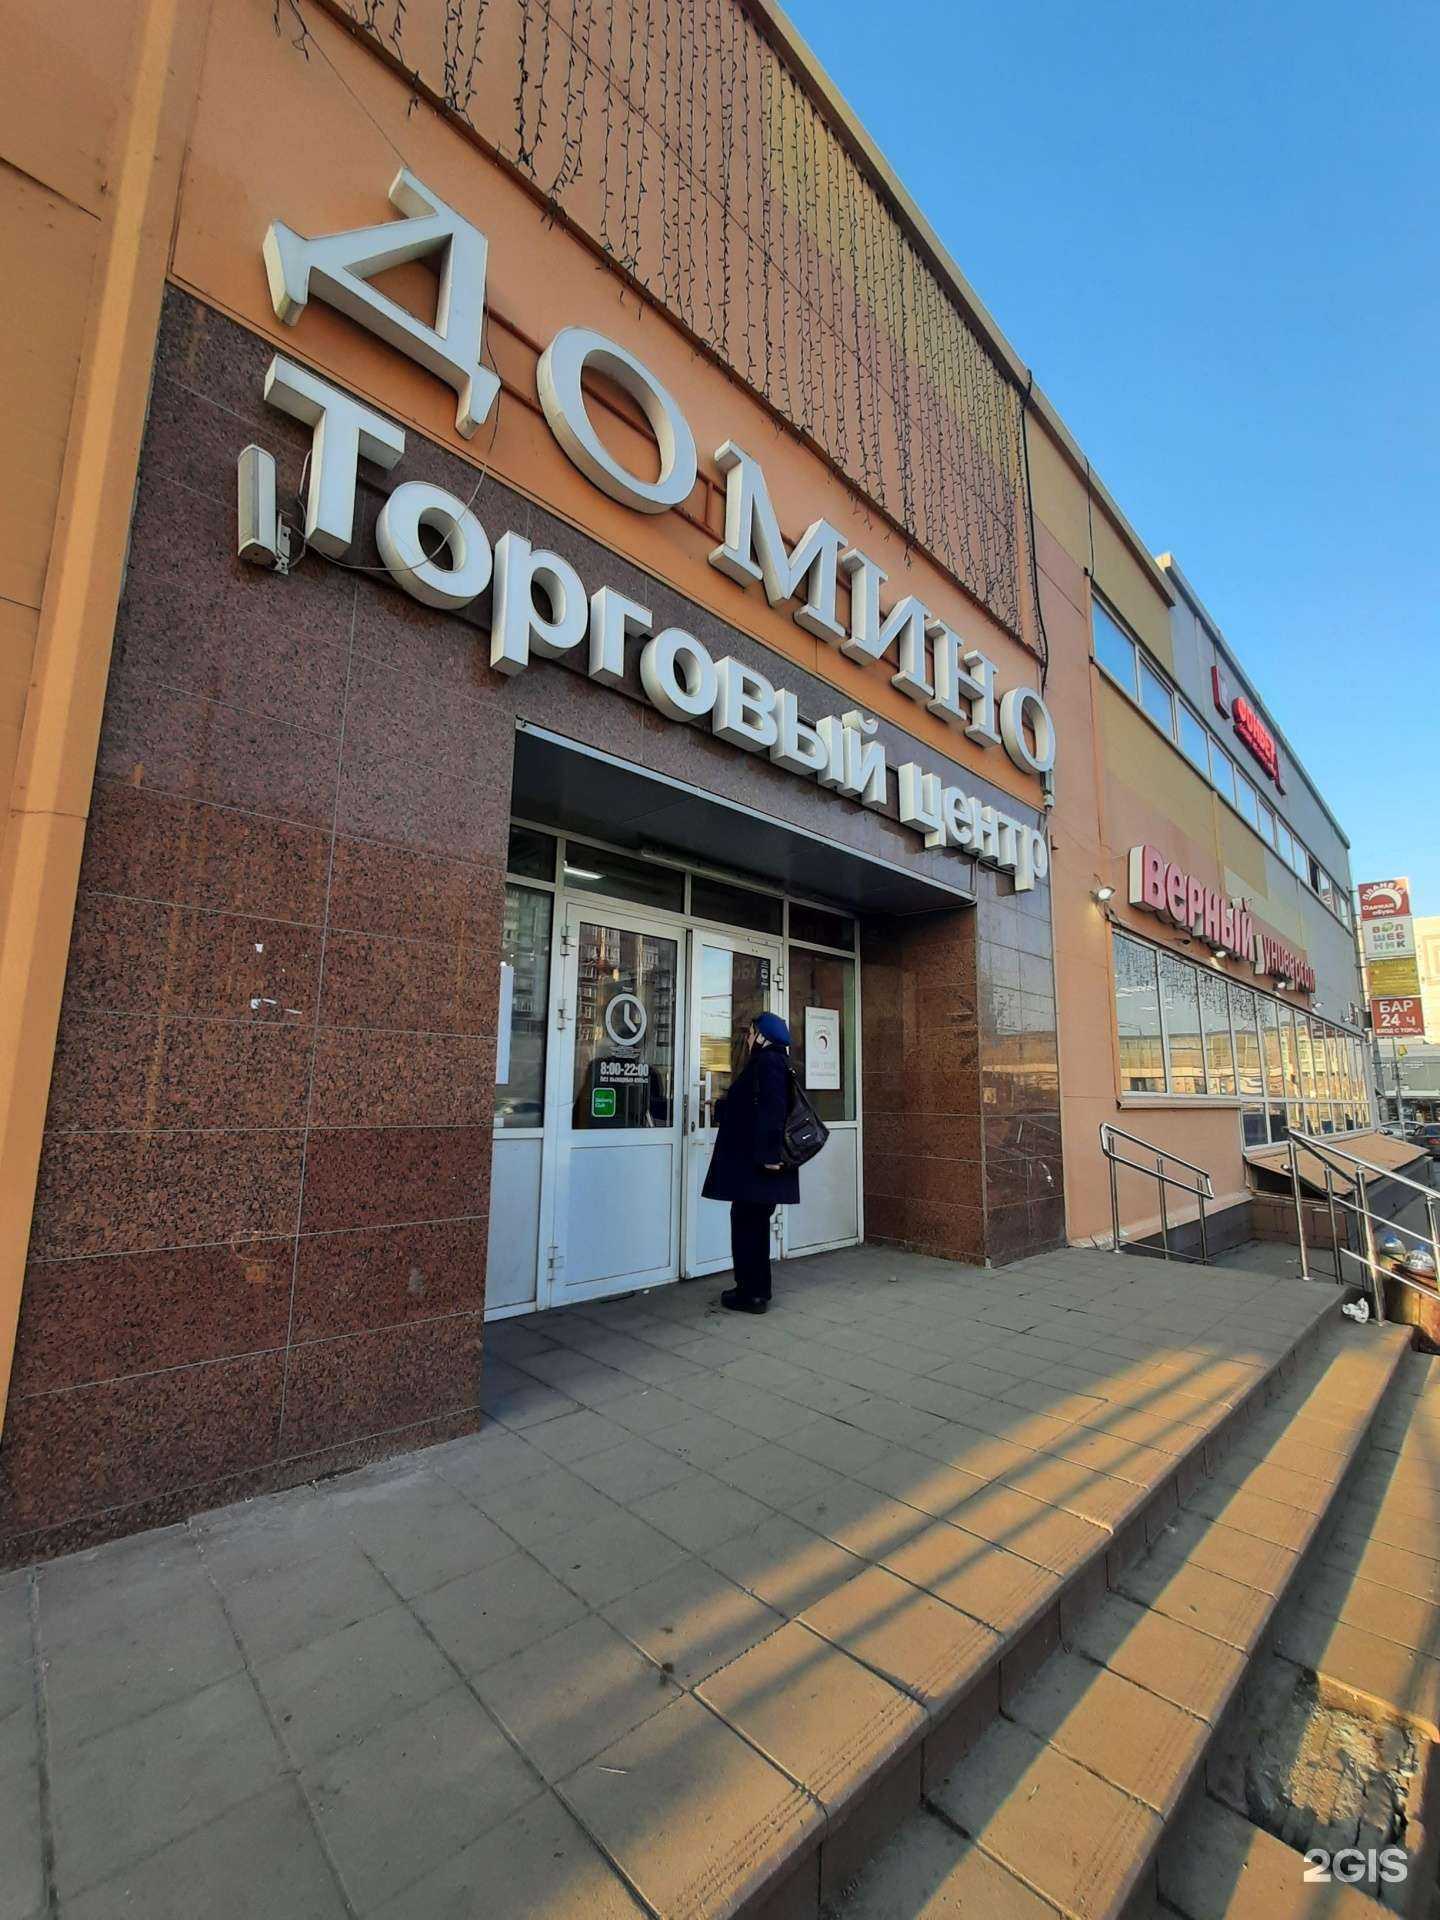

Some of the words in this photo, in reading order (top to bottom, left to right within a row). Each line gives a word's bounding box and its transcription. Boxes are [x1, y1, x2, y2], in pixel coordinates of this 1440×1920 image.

[263, 167, 1056, 775] ДОМИНО
[264, 354, 887, 807] Торговый
[899, 762, 1048, 892] центр
[1129, 845, 1256, 962] Верный
[1379, 1000, 1414, 1013] БАР
[1381, 1013, 1400, 1027] 24
